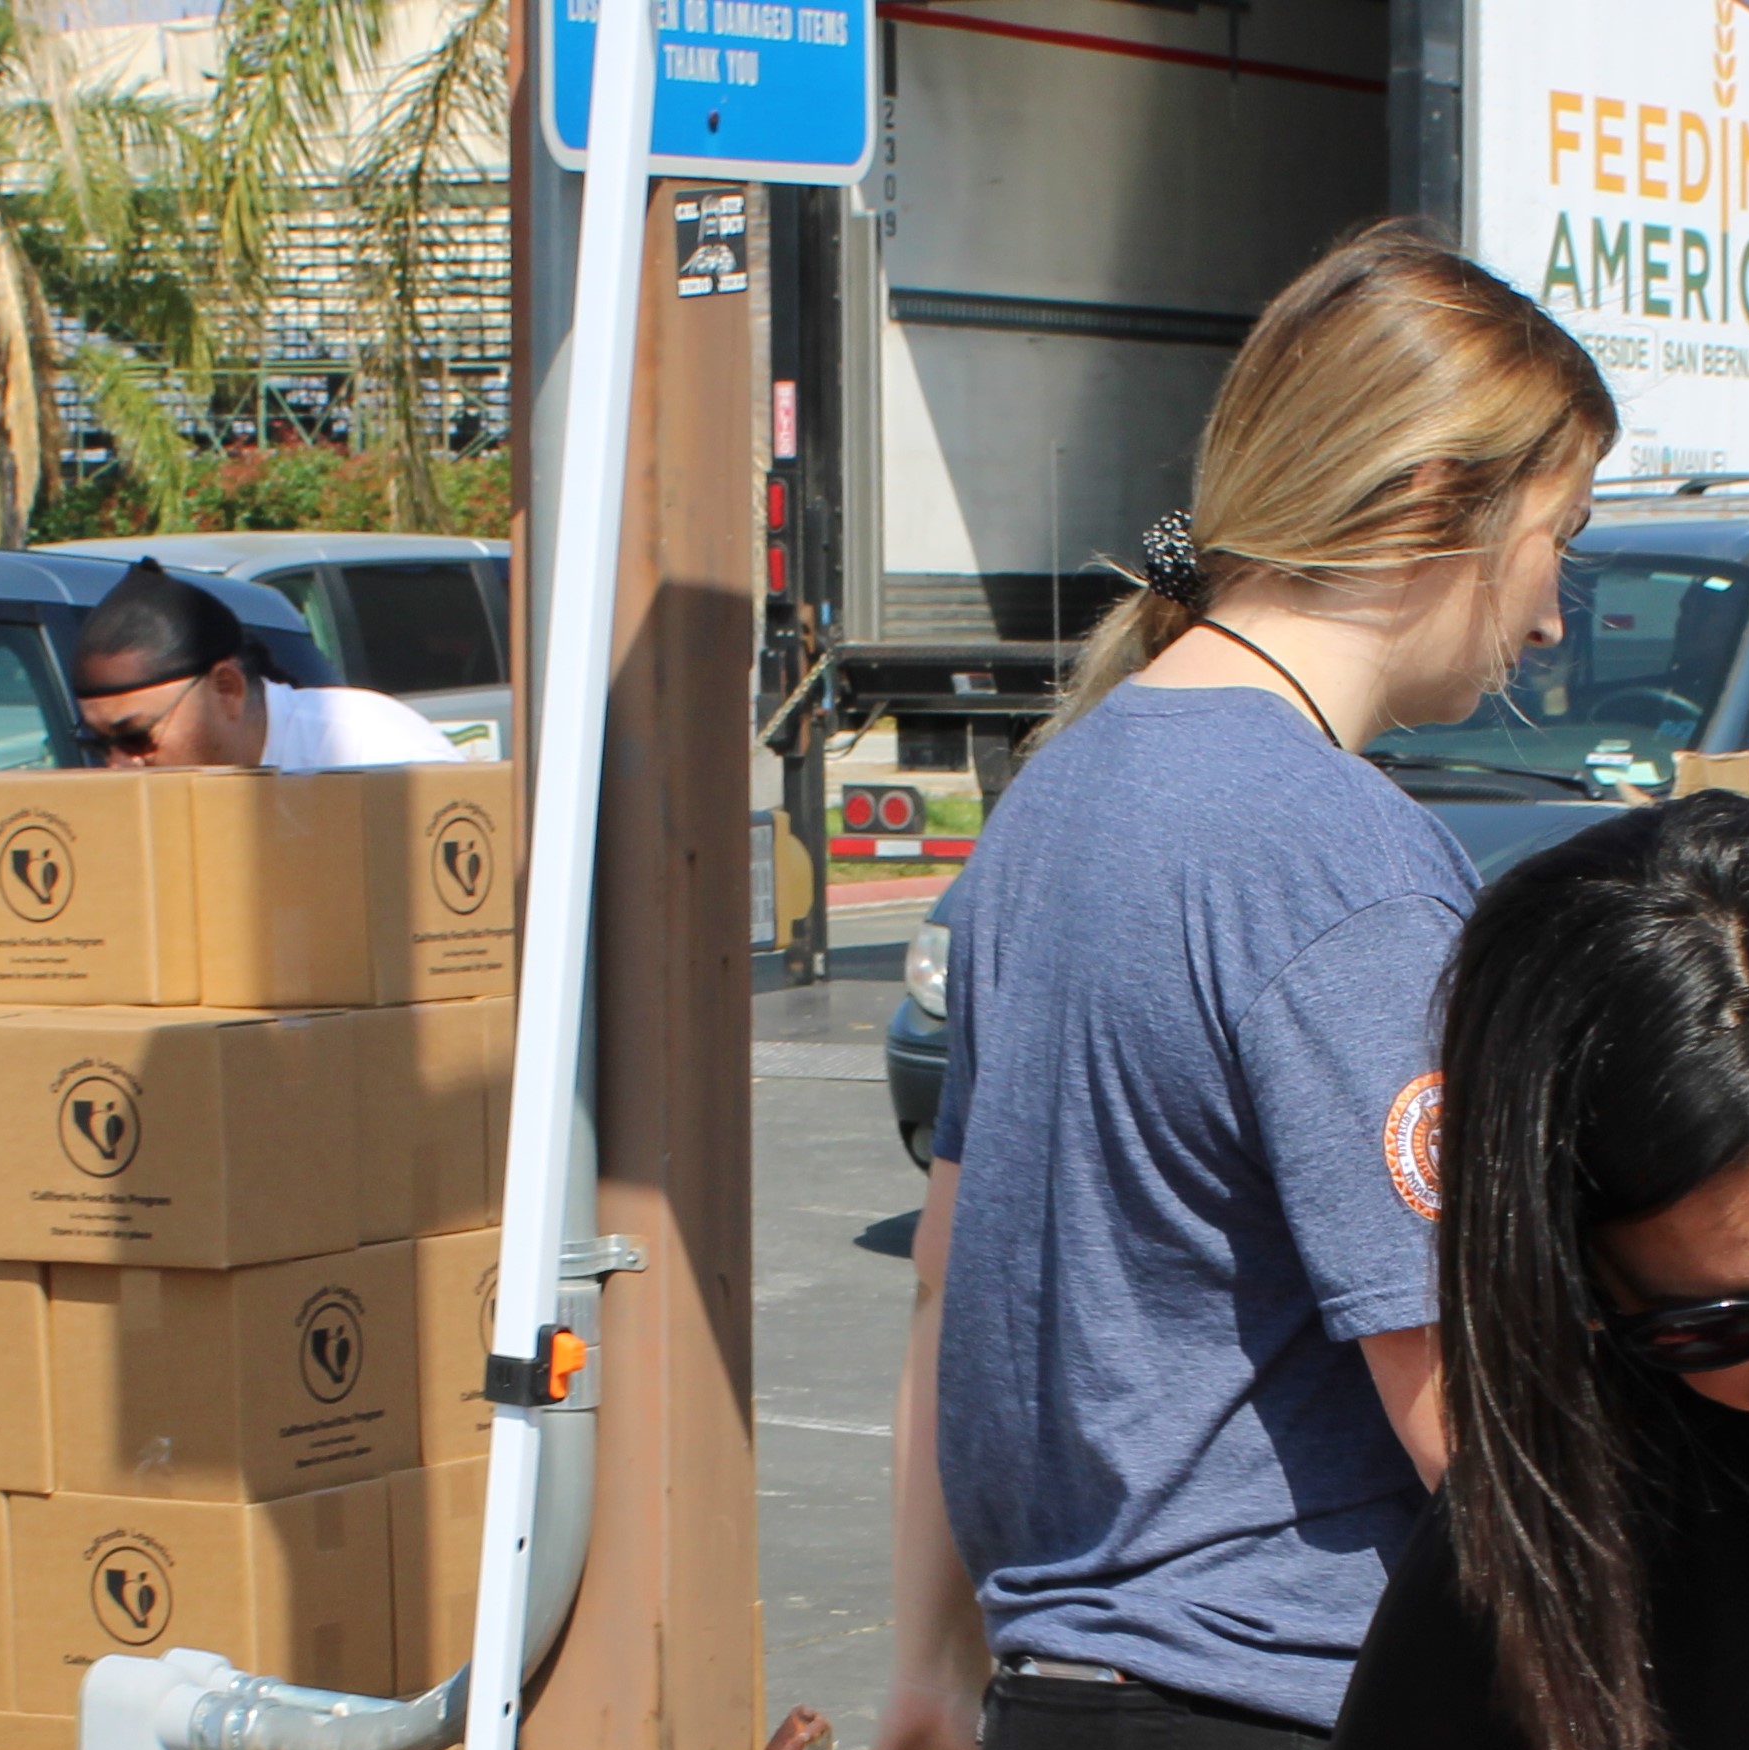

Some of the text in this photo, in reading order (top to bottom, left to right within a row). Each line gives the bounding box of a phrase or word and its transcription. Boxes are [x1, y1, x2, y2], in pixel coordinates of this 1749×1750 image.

[713, 1, 793, 40] DAMAGED
[798, 8, 849, 46] ITEMS
[663, 44, 759, 86] THANK YOU
[1663, 339, 1698, 375] SAN
